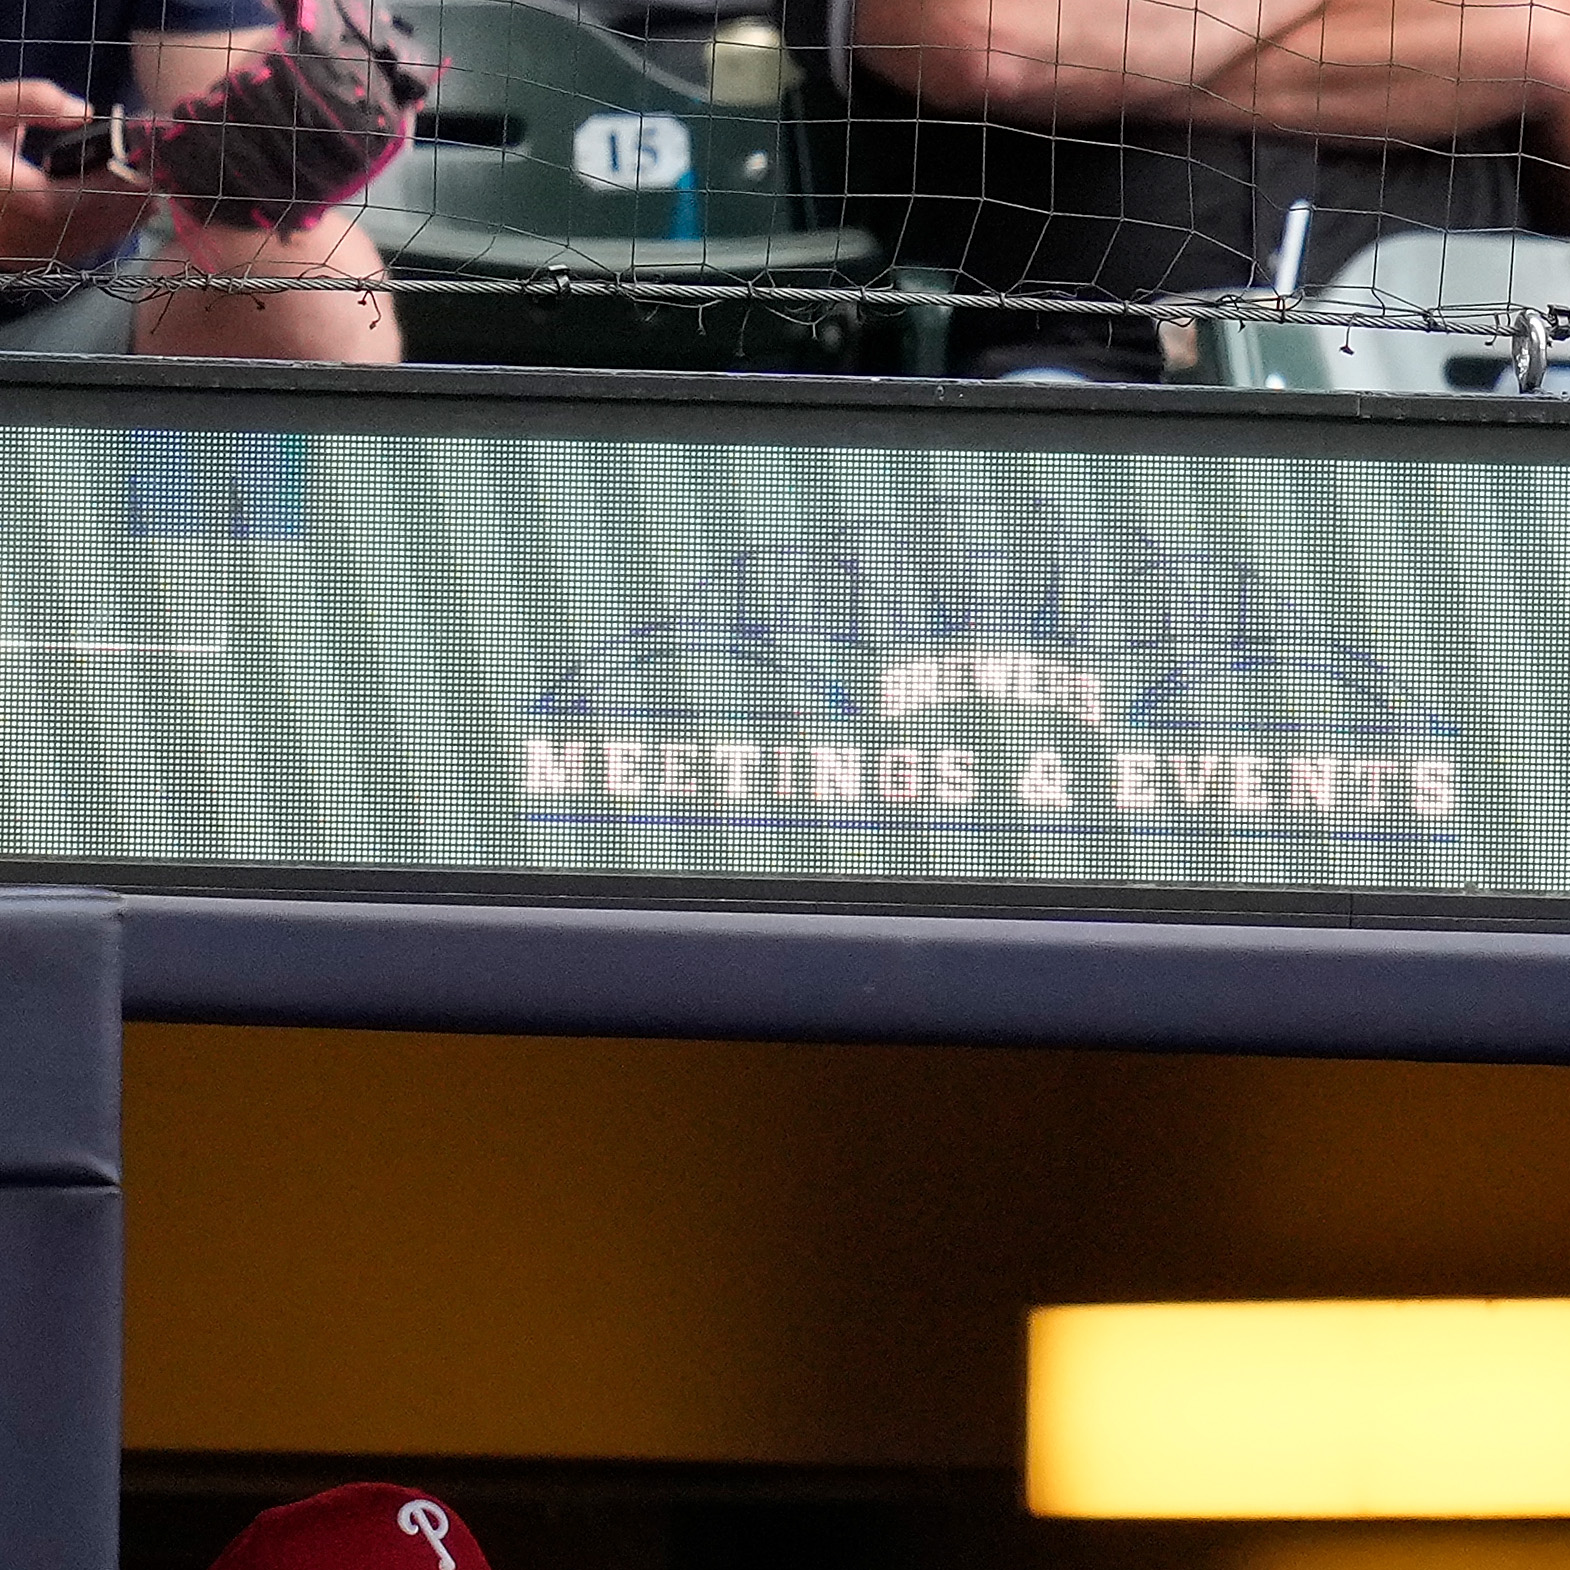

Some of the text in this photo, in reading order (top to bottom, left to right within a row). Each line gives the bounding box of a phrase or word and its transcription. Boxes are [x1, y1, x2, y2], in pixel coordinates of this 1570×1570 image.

[880, 648, 1104, 734] BREWERS
[523, 737, 1457, 818] MEETINGS & EVENTS
